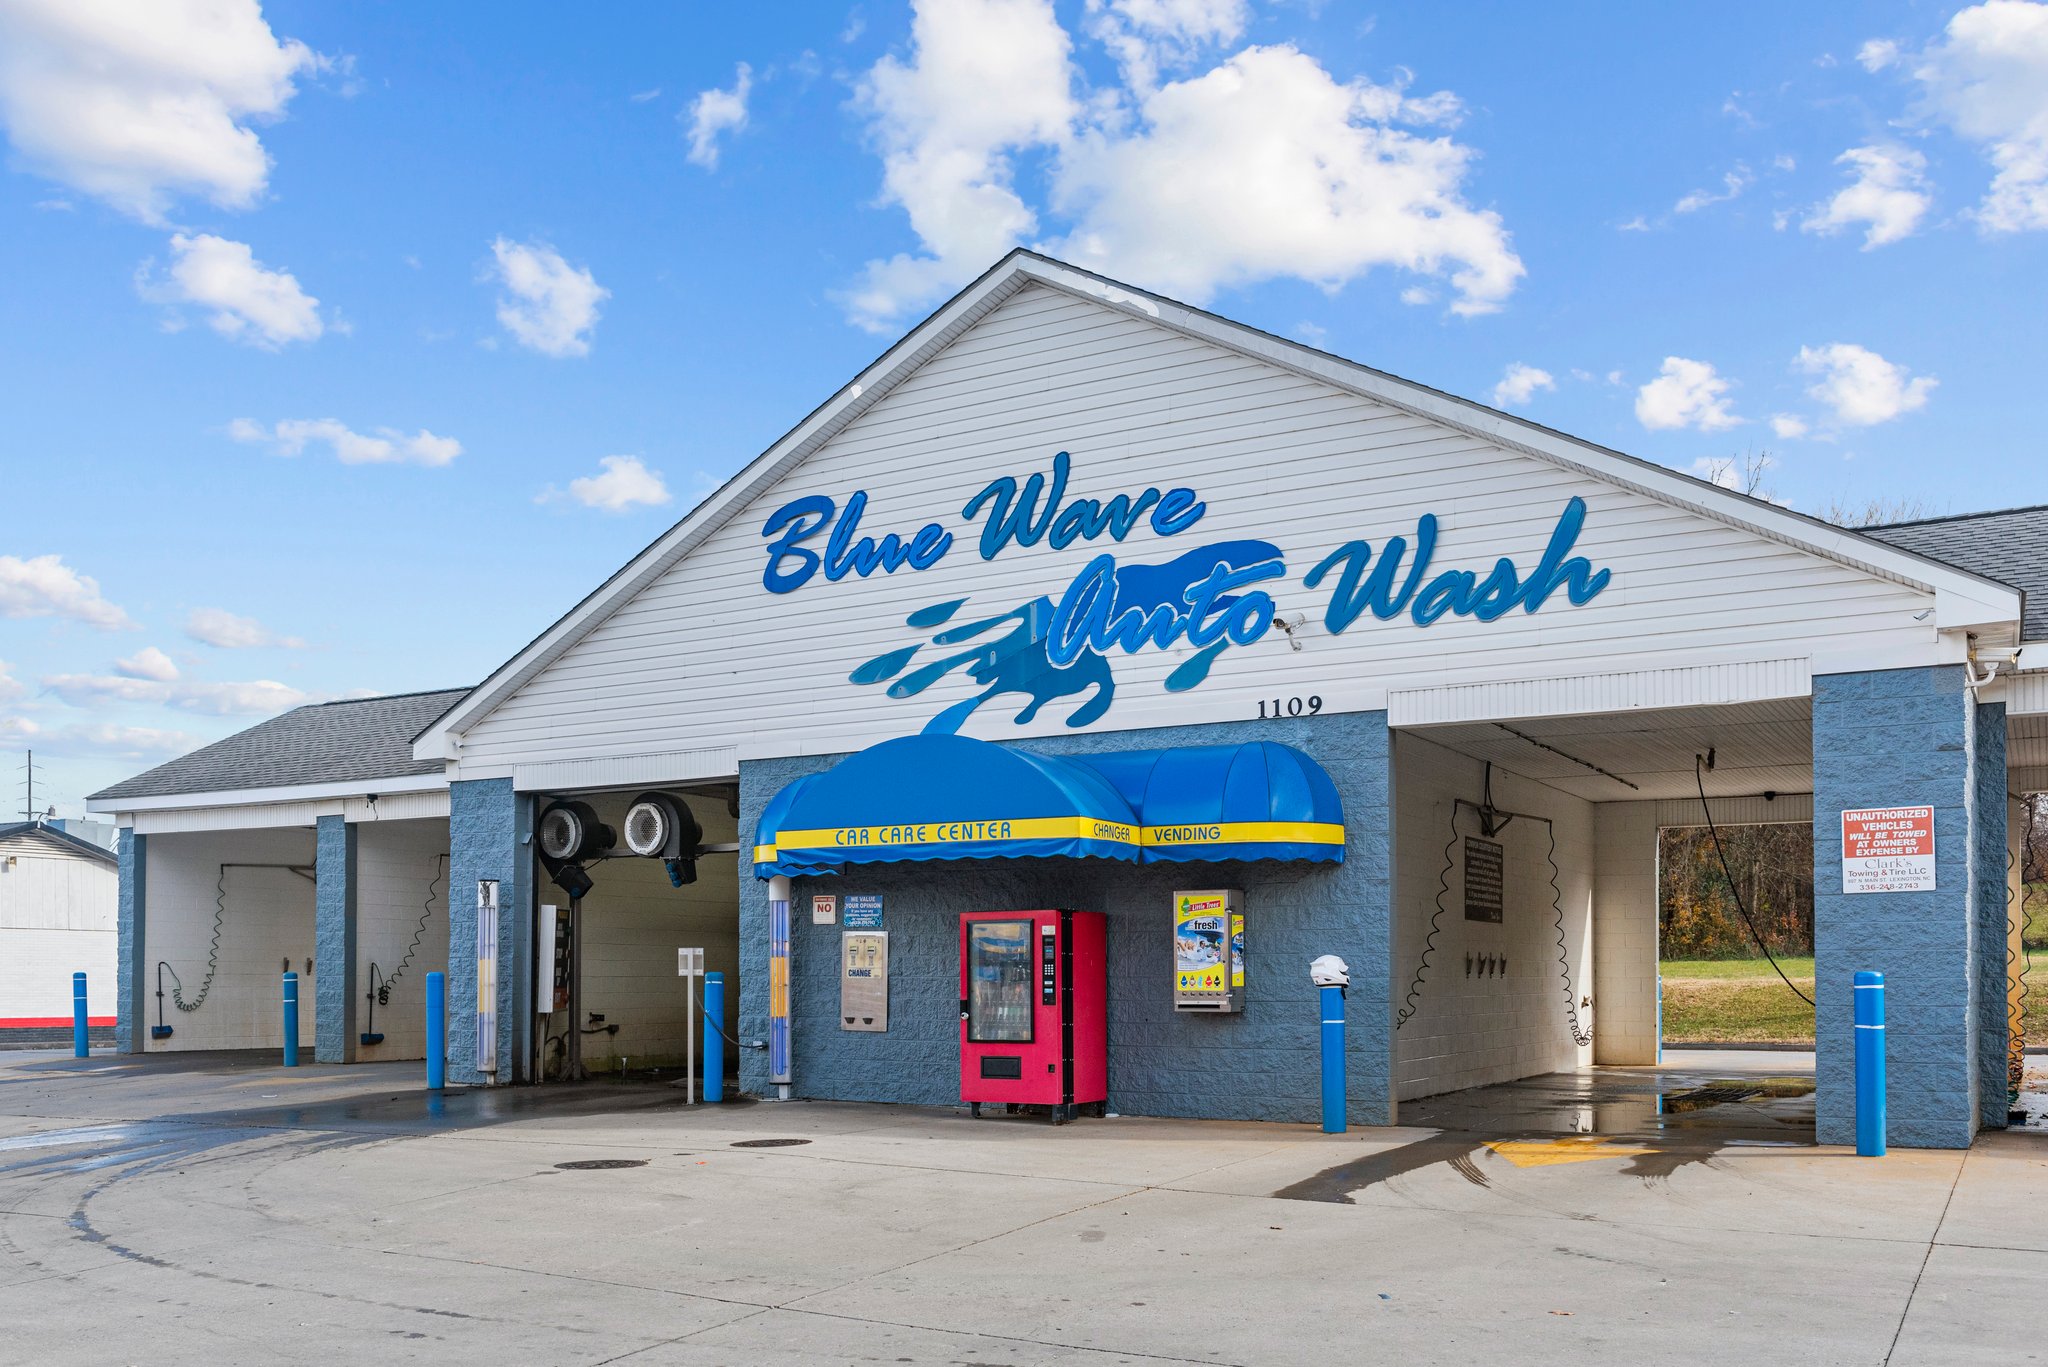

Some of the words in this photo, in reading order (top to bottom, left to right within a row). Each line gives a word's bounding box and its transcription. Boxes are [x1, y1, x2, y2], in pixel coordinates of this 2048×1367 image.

[762, 490, 953, 594] Blue
[962, 451, 1206, 561] Wave
[1046, 553, 1287, 668] Auto
[1303, 496, 1611, 635] Wash
[1258, 695, 1322, 719] 1109
[1846, 809, 1928, 821] UNAUTHORIZED
[1862, 821, 1913, 831] VEHICLES
[835, 829, 869, 845] CAR
[879, 826, 926, 843] CARE
[937, 821, 1011, 841] CENTER
[1093, 823, 1130, 841] CHANGER
[1154, 826, 1221, 841] VENDING
[1849, 832, 1871, 840] WILL
[1875, 831, 1887, 839] BE
[1893, 830, 1927, 838] TOWED
[1873, 839, 1916, 847] OWNERS
[1856, 847, 1903, 856] EXPENSE
[1906, 846, 1919, 854] BY
[1864, 858, 1912, 869] Clark's
[1860, 882, 1919, 891] 336-248-2743
[817, 904, 832, 912] NO
[1194, 920, 1218, 930] fresh
[848, 969, 871, 977] CHANGE
